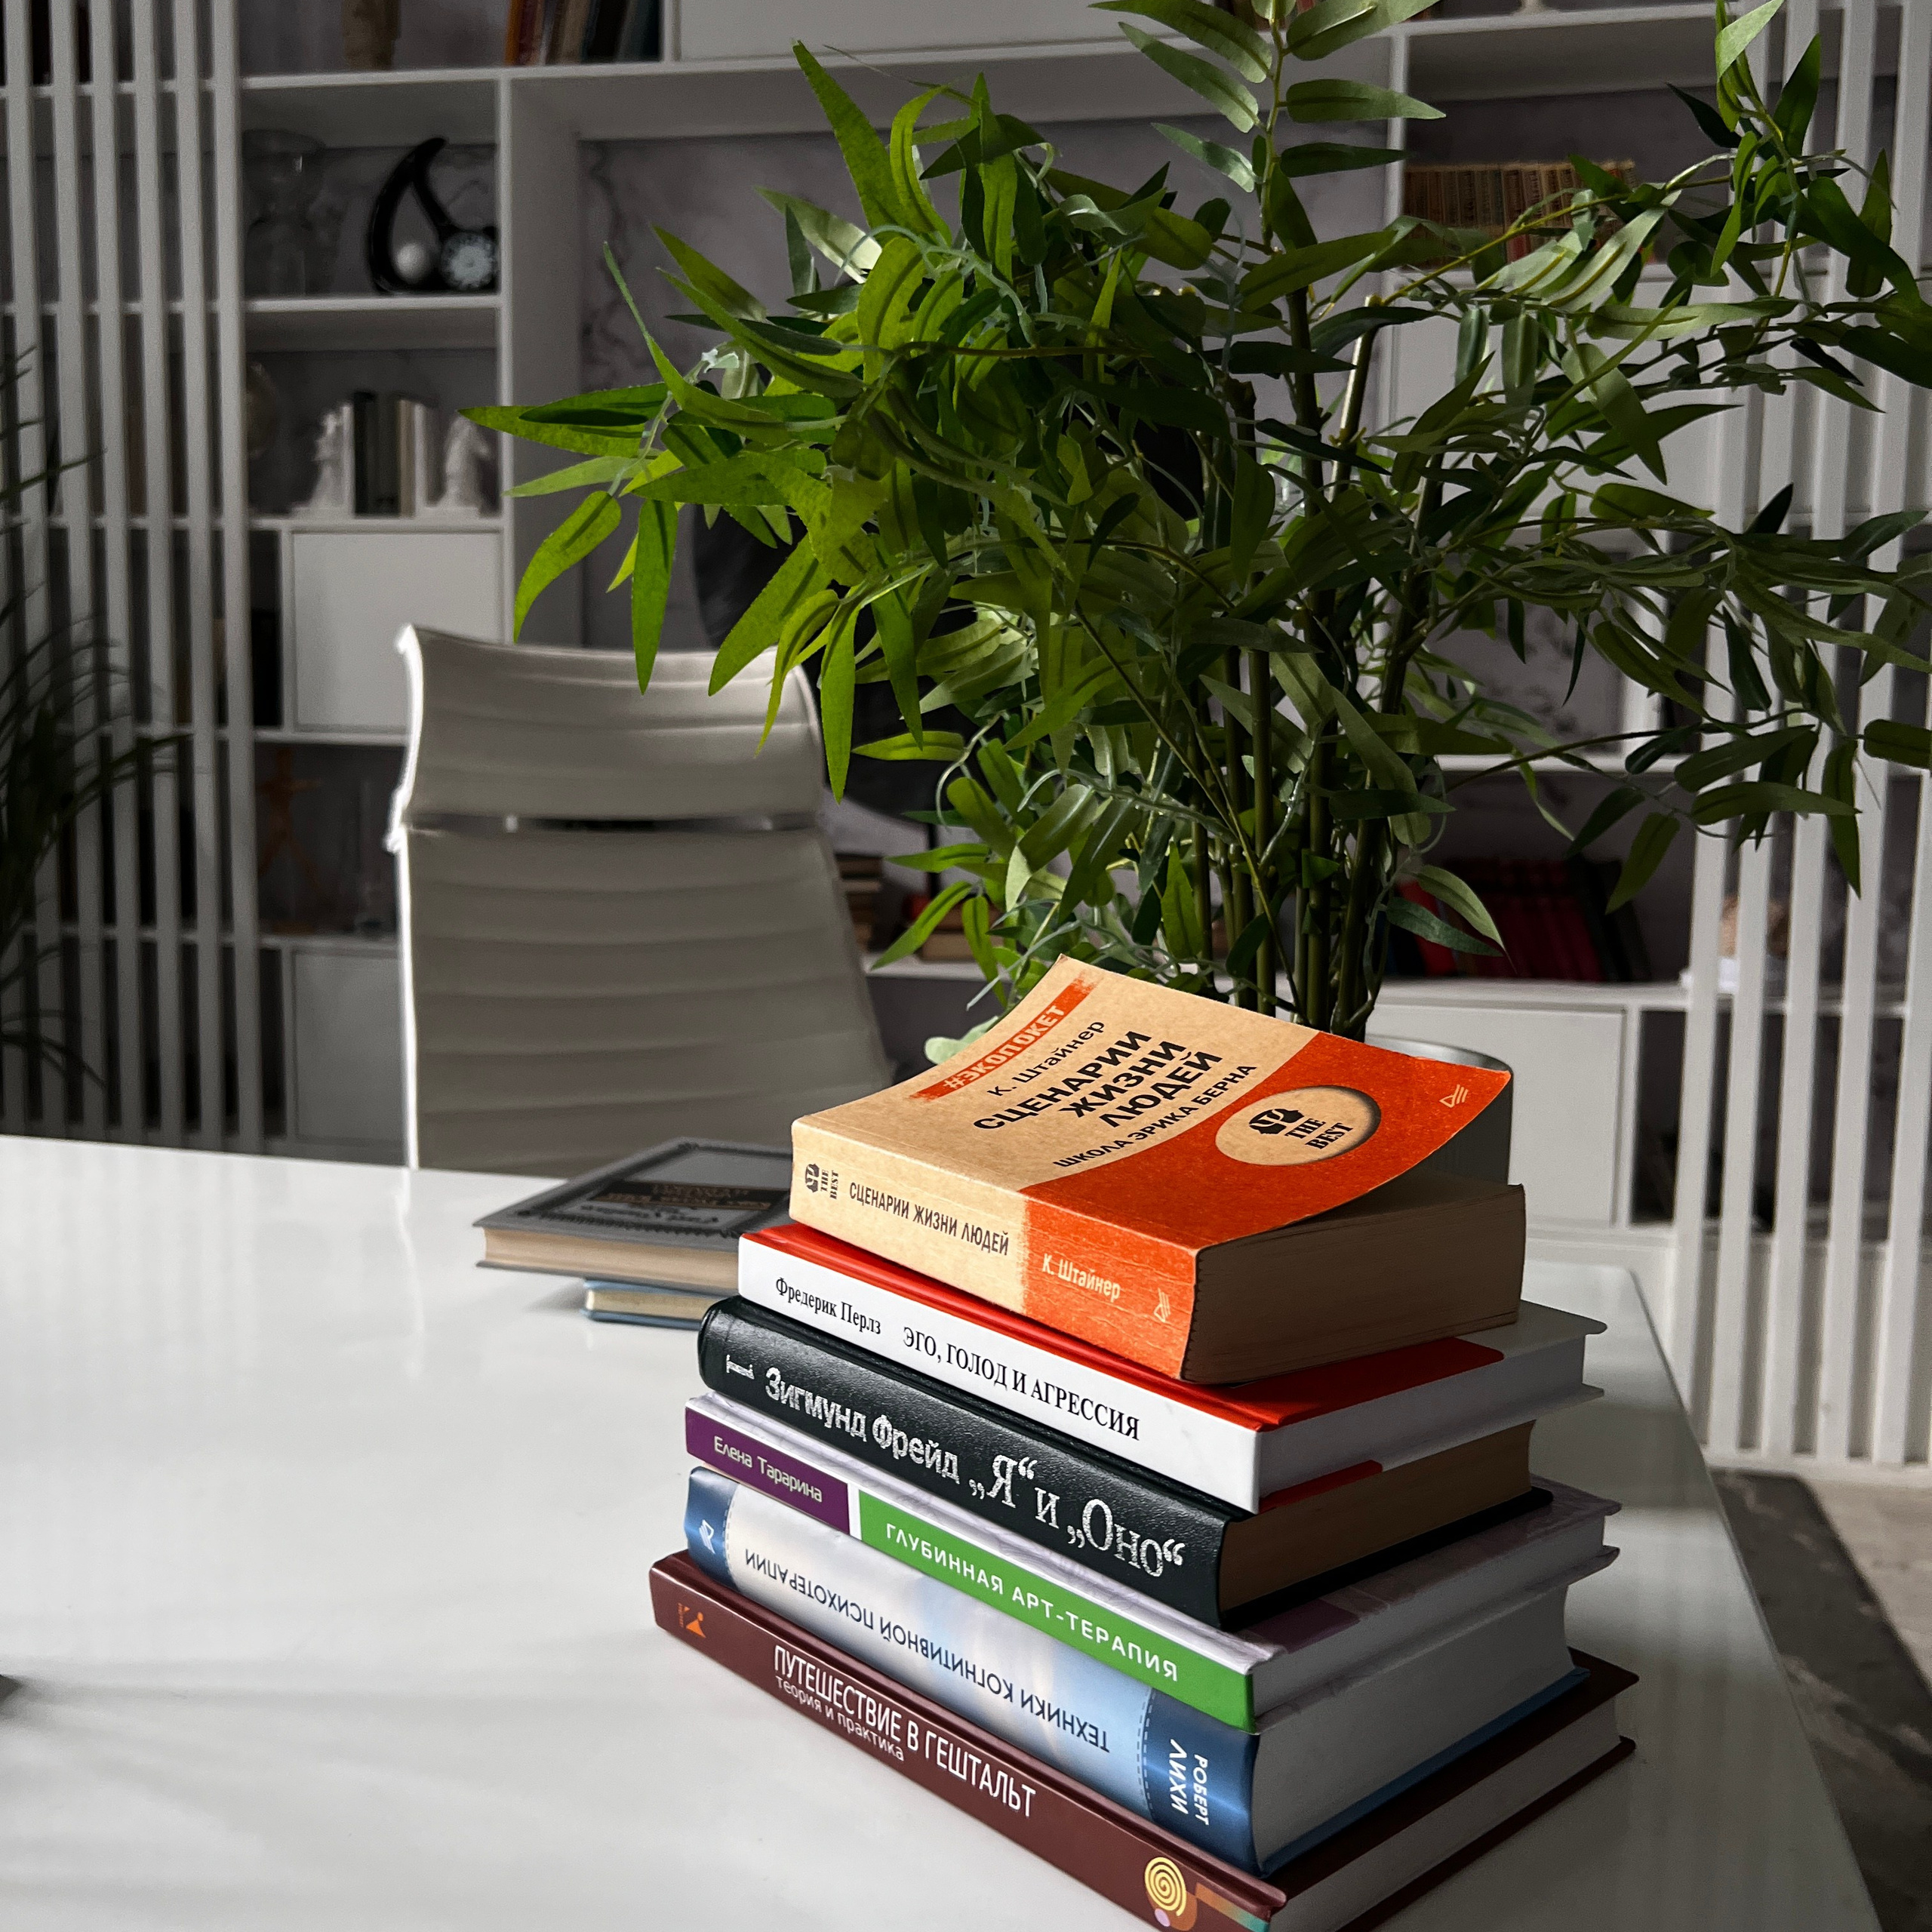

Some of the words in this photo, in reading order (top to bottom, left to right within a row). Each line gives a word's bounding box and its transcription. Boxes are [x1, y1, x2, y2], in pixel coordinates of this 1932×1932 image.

[943, 1005, 1066, 1089] #ЭКОПОКЕТ
[974, 1031, 1152, 1131] СЦЕНАРИИ
[987, 1084, 1017, 1097] К.
[1013, 1021, 1104, 1083] Штайнер
[1059, 1041, 1186, 1118] ЖИЗНИ
[1054, 1139, 1128, 1168] ШКОЛА
[1128, 1104, 1198, 1144] ЭРИКА
[1192, 1065, 1257, 1106] БЕРНА
[1099, 1051, 1223, 1128] ЛЮДЕЙ
[1284, 1118, 1326, 1140] THE
[1305, 1122, 1354, 1149] BEST
[849, 1182, 909, 1220] СЦЕНАРИИ
[912, 1202, 958, 1236] ЖИЗНИ
[961, 1222, 1010, 1257] ЛЮДЕЙ
[776, 1277, 837, 1318] Фредерик
[841, 1302, 881, 1335] Перлз
[1042, 1253, 1057, 1275] К.
[1058, 1257, 1121, 1303] Штайнер
[903, 1326, 941, 1362] ЭГО,
[946, 1344, 1008, 1388] ГОЛОД
[1011, 1370, 1027, 1394] И
[1031, 1379, 1140, 1441] АГРЕССИЯ
[765, 1367, 867, 1441] Зигмунд
[872, 1414, 960, 1484] Фрейд
[714, 1436, 752, 1468] Елена
[757, 1457, 822, 1503] Тарарина
[744, 1548, 875, 1631] ПСИХОТЕРАПИИ
[885, 1524, 1004, 1595] ГЛУБИННАЯ
[1011, 1586, 1179, 1683] АРТ-ТЕРАПИЯ
[879, 1616, 1014, 1704] КОГНИТИВНОЙ
[774, 1645, 901, 1745] ПУТЕШЕСТВИЕ
[907, 1720, 918, 1751] В
[924, 1728, 1037, 1818] ГЕШТАЛЬТ
[775, 1676, 823, 1714] теория
[824, 1703, 835, 1719] и
[837, 1711, 904, 1761] практика
[1020, 1688, 1109, 1754] ТЕХНИКИ
[1169, 1738, 1188, 1814] ЛИХИ
[1192, 1755, 1208, 1826] РОБЕРТ
